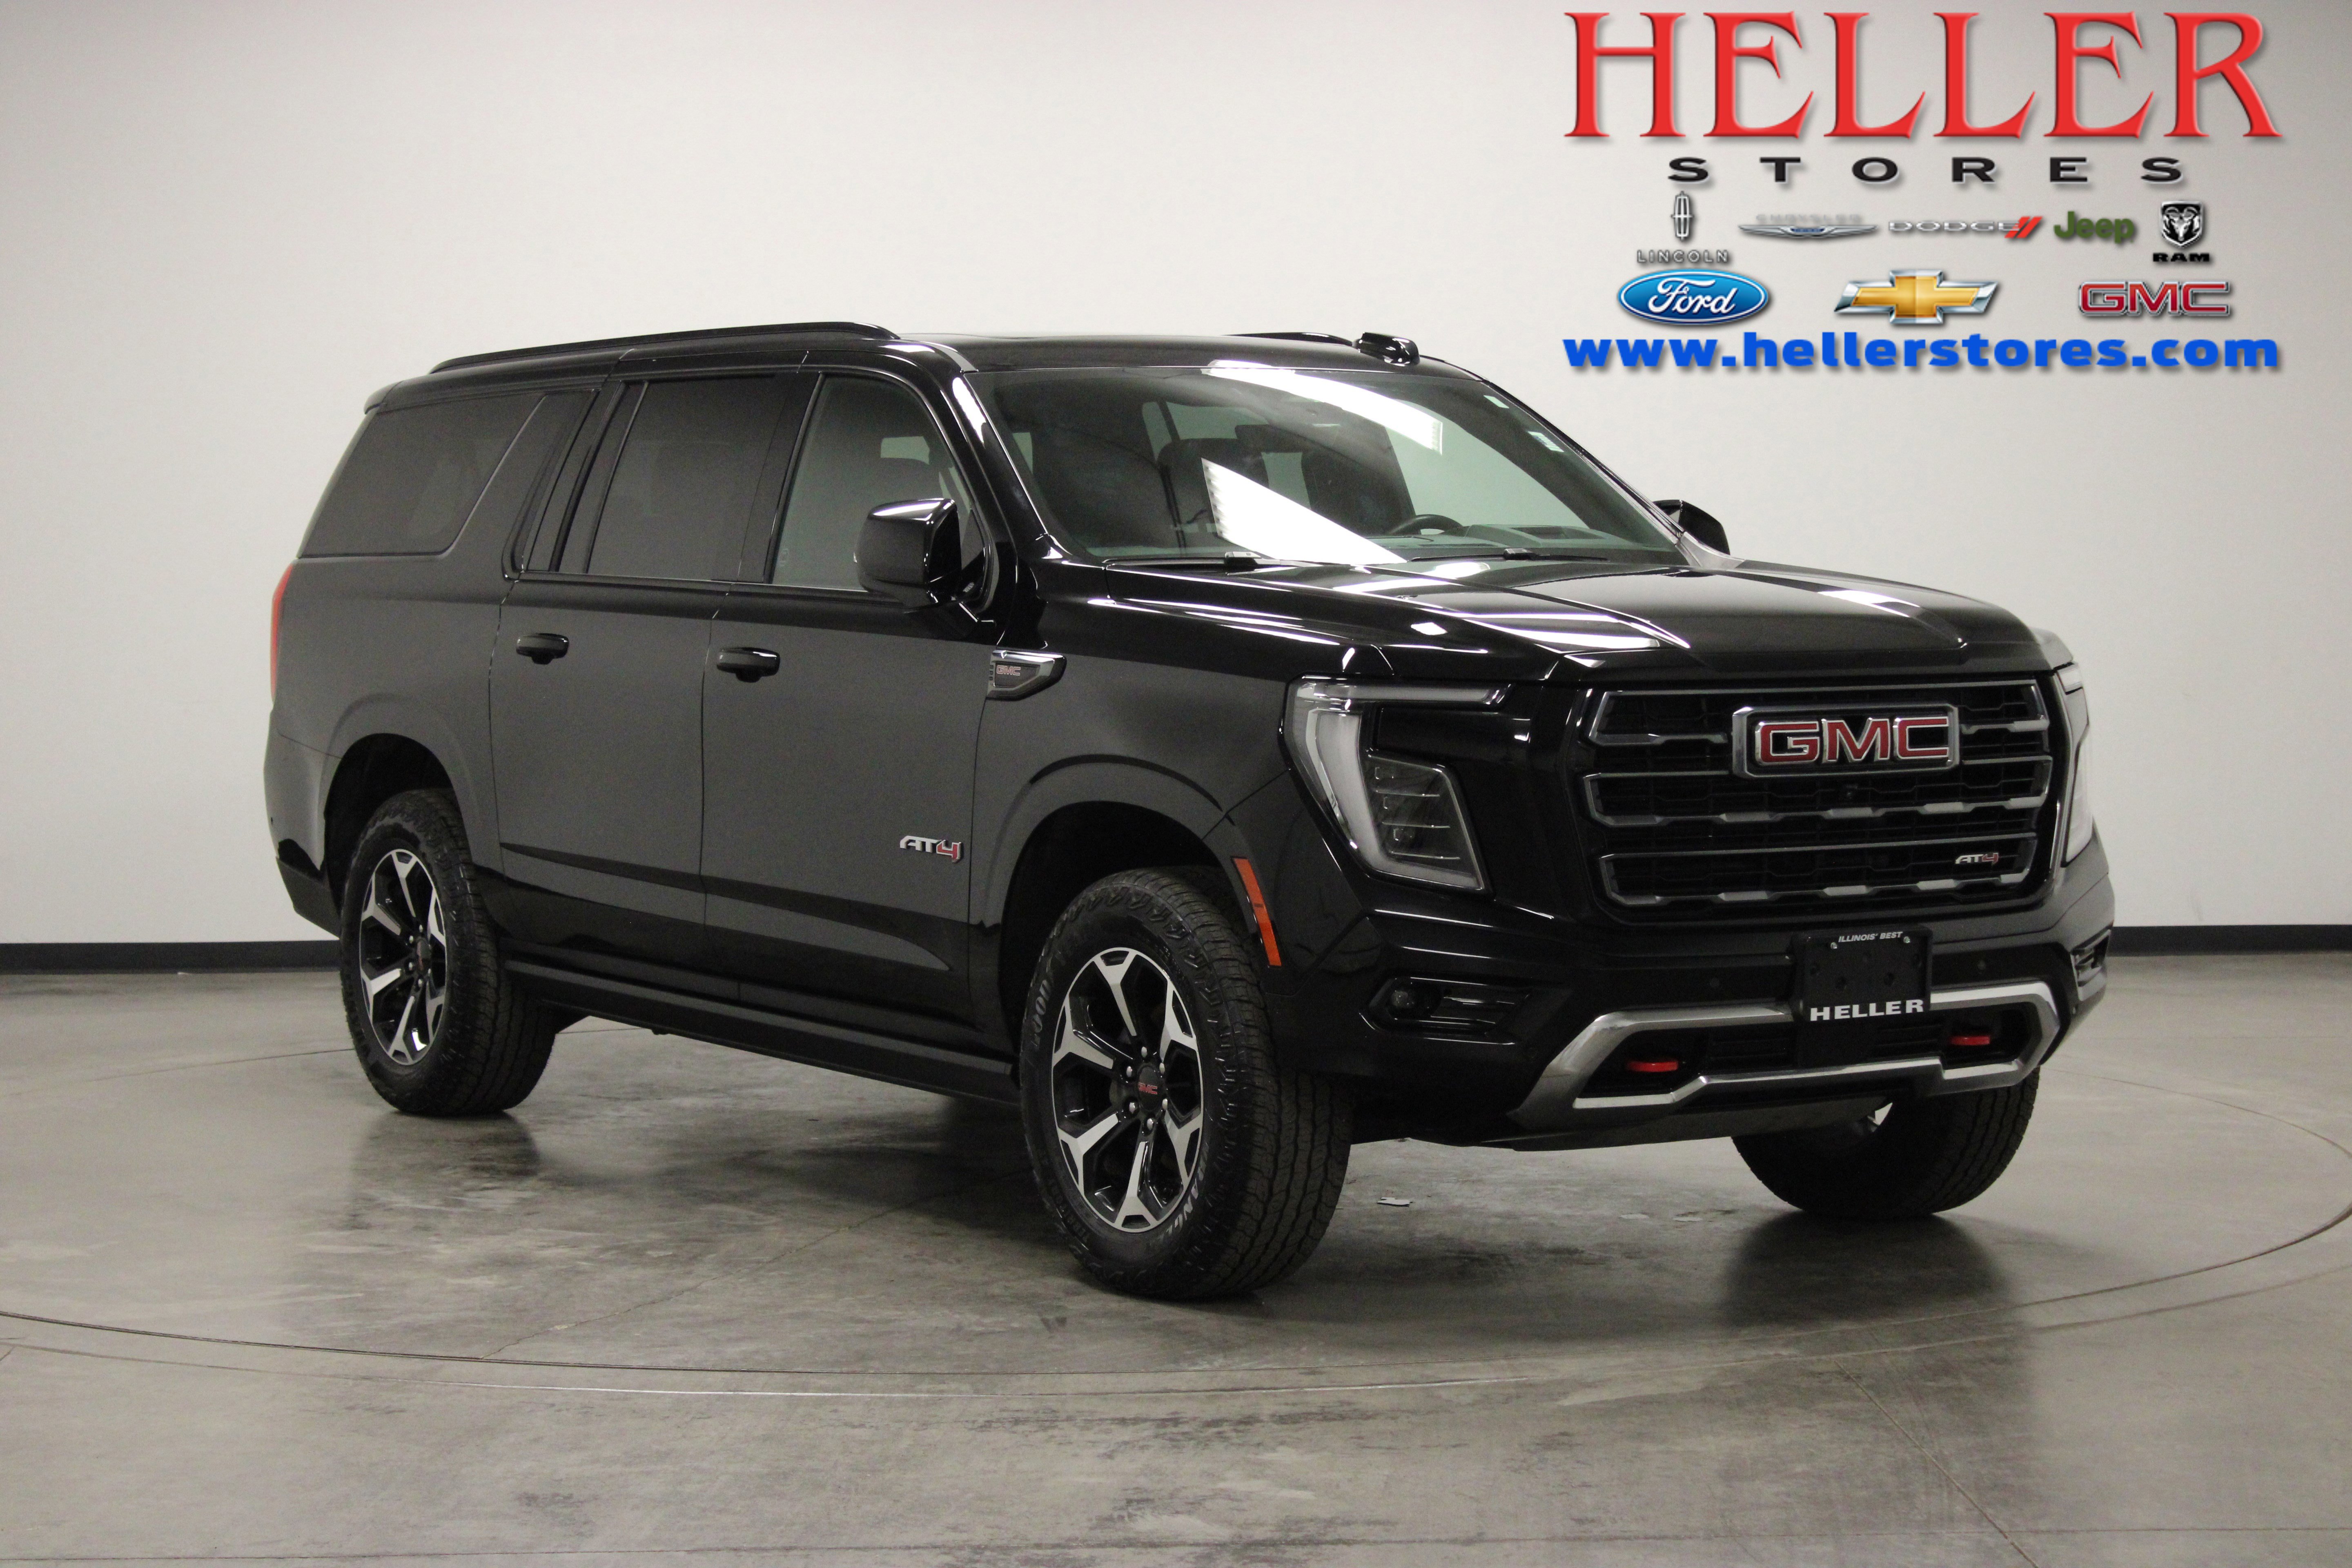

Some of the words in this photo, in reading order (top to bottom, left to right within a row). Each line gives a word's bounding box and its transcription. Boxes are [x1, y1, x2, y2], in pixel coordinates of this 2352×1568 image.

[996, 665, 1021, 677] GMC
[1755, 717, 1951, 765] GMC
[900, 835, 962, 863] AT4
[1955, 852, 1999, 865] AT4
[1838, 934, 1878, 943] ILLINOIS'
[1880, 931, 1903, 940] BEST
[1810, 999, 1924, 1021] HELLER
[1138, 1082, 1158, 1095] GMC
